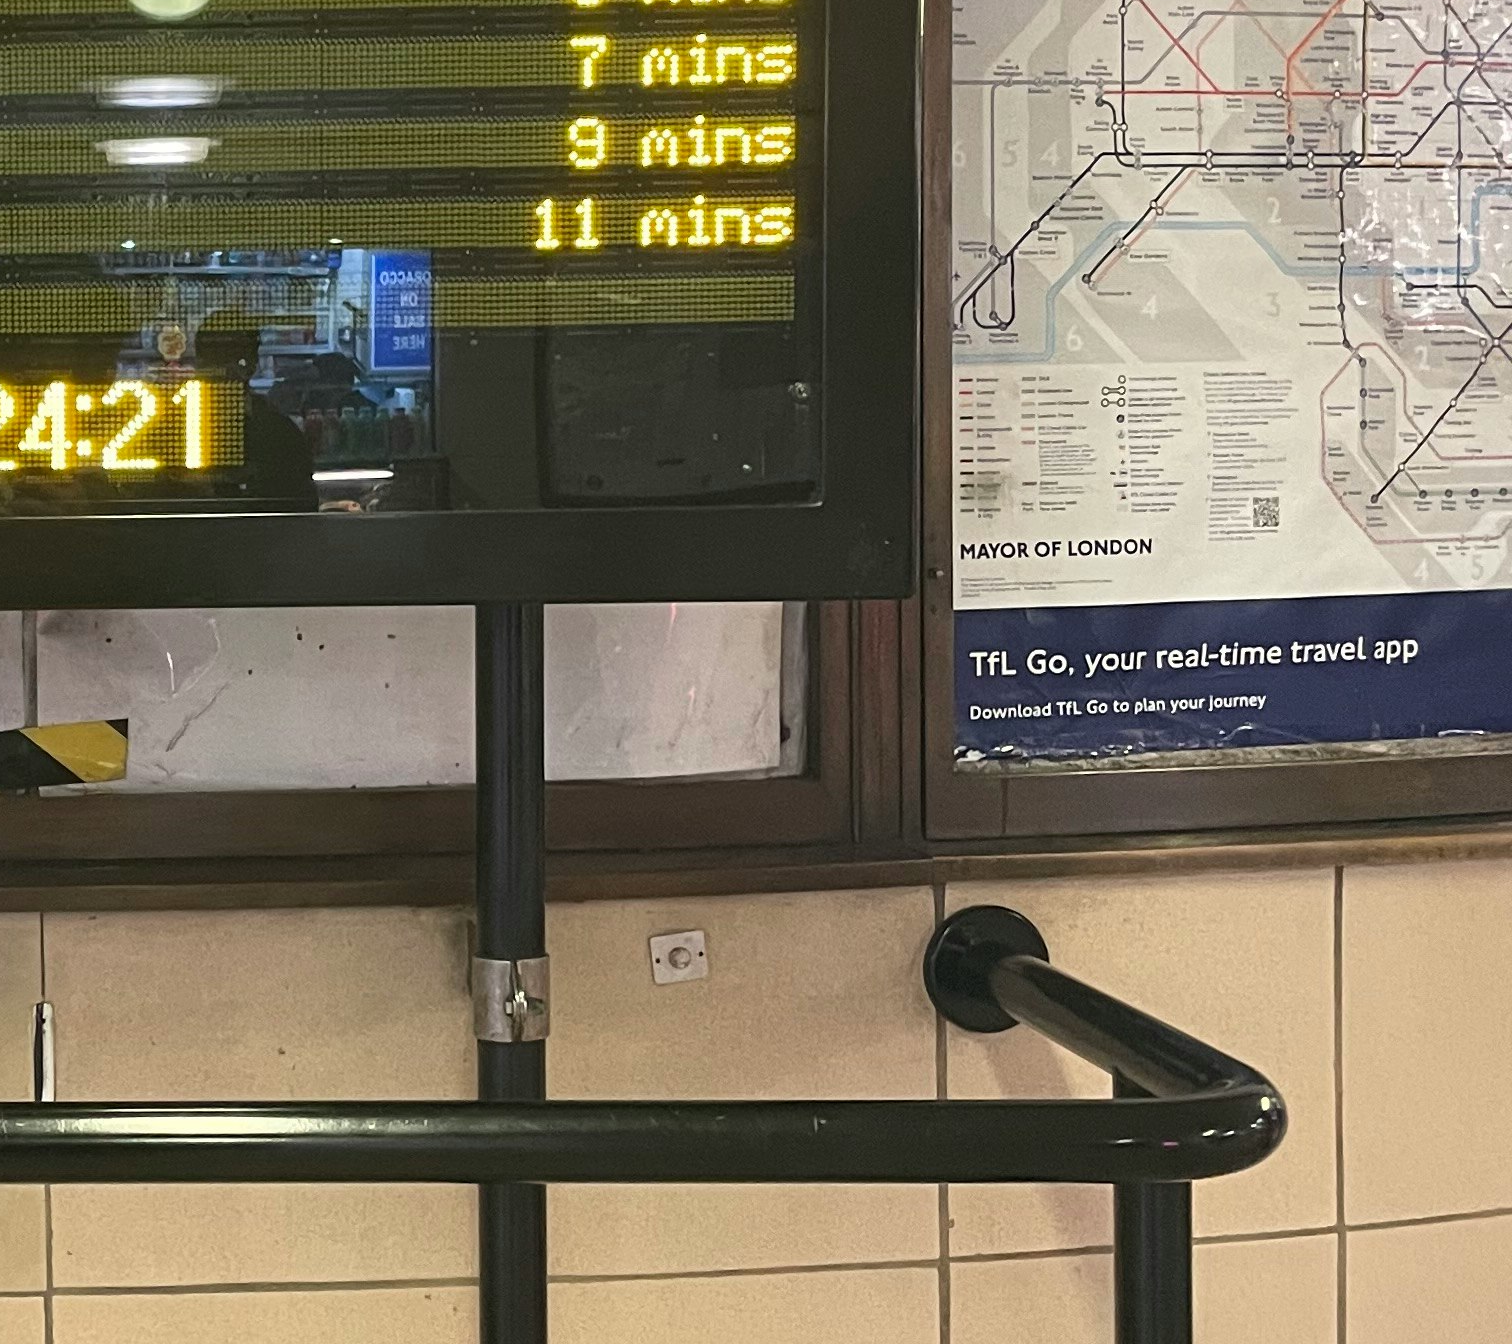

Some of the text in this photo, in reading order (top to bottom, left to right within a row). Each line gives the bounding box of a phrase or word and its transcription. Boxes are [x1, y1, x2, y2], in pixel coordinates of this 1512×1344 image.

[568, 34, 609, 89] 7
[640, 32, 795, 87] mins
[566, 116, 608, 169] 9
[640, 113, 796, 168] mins
[534, 197, 601, 251] 11
[638, 193, 794, 248] mins
[1141, 295, 1159, 320] 4
[1066, 327, 1084, 352] 6
[960, 538, 1153, 560] MAYOR OF LONDON
[969, 636, 1419, 679] TfL Go, your real-time travel app
[969, 694, 1267, 720] Download TfL Go to plan your journey
